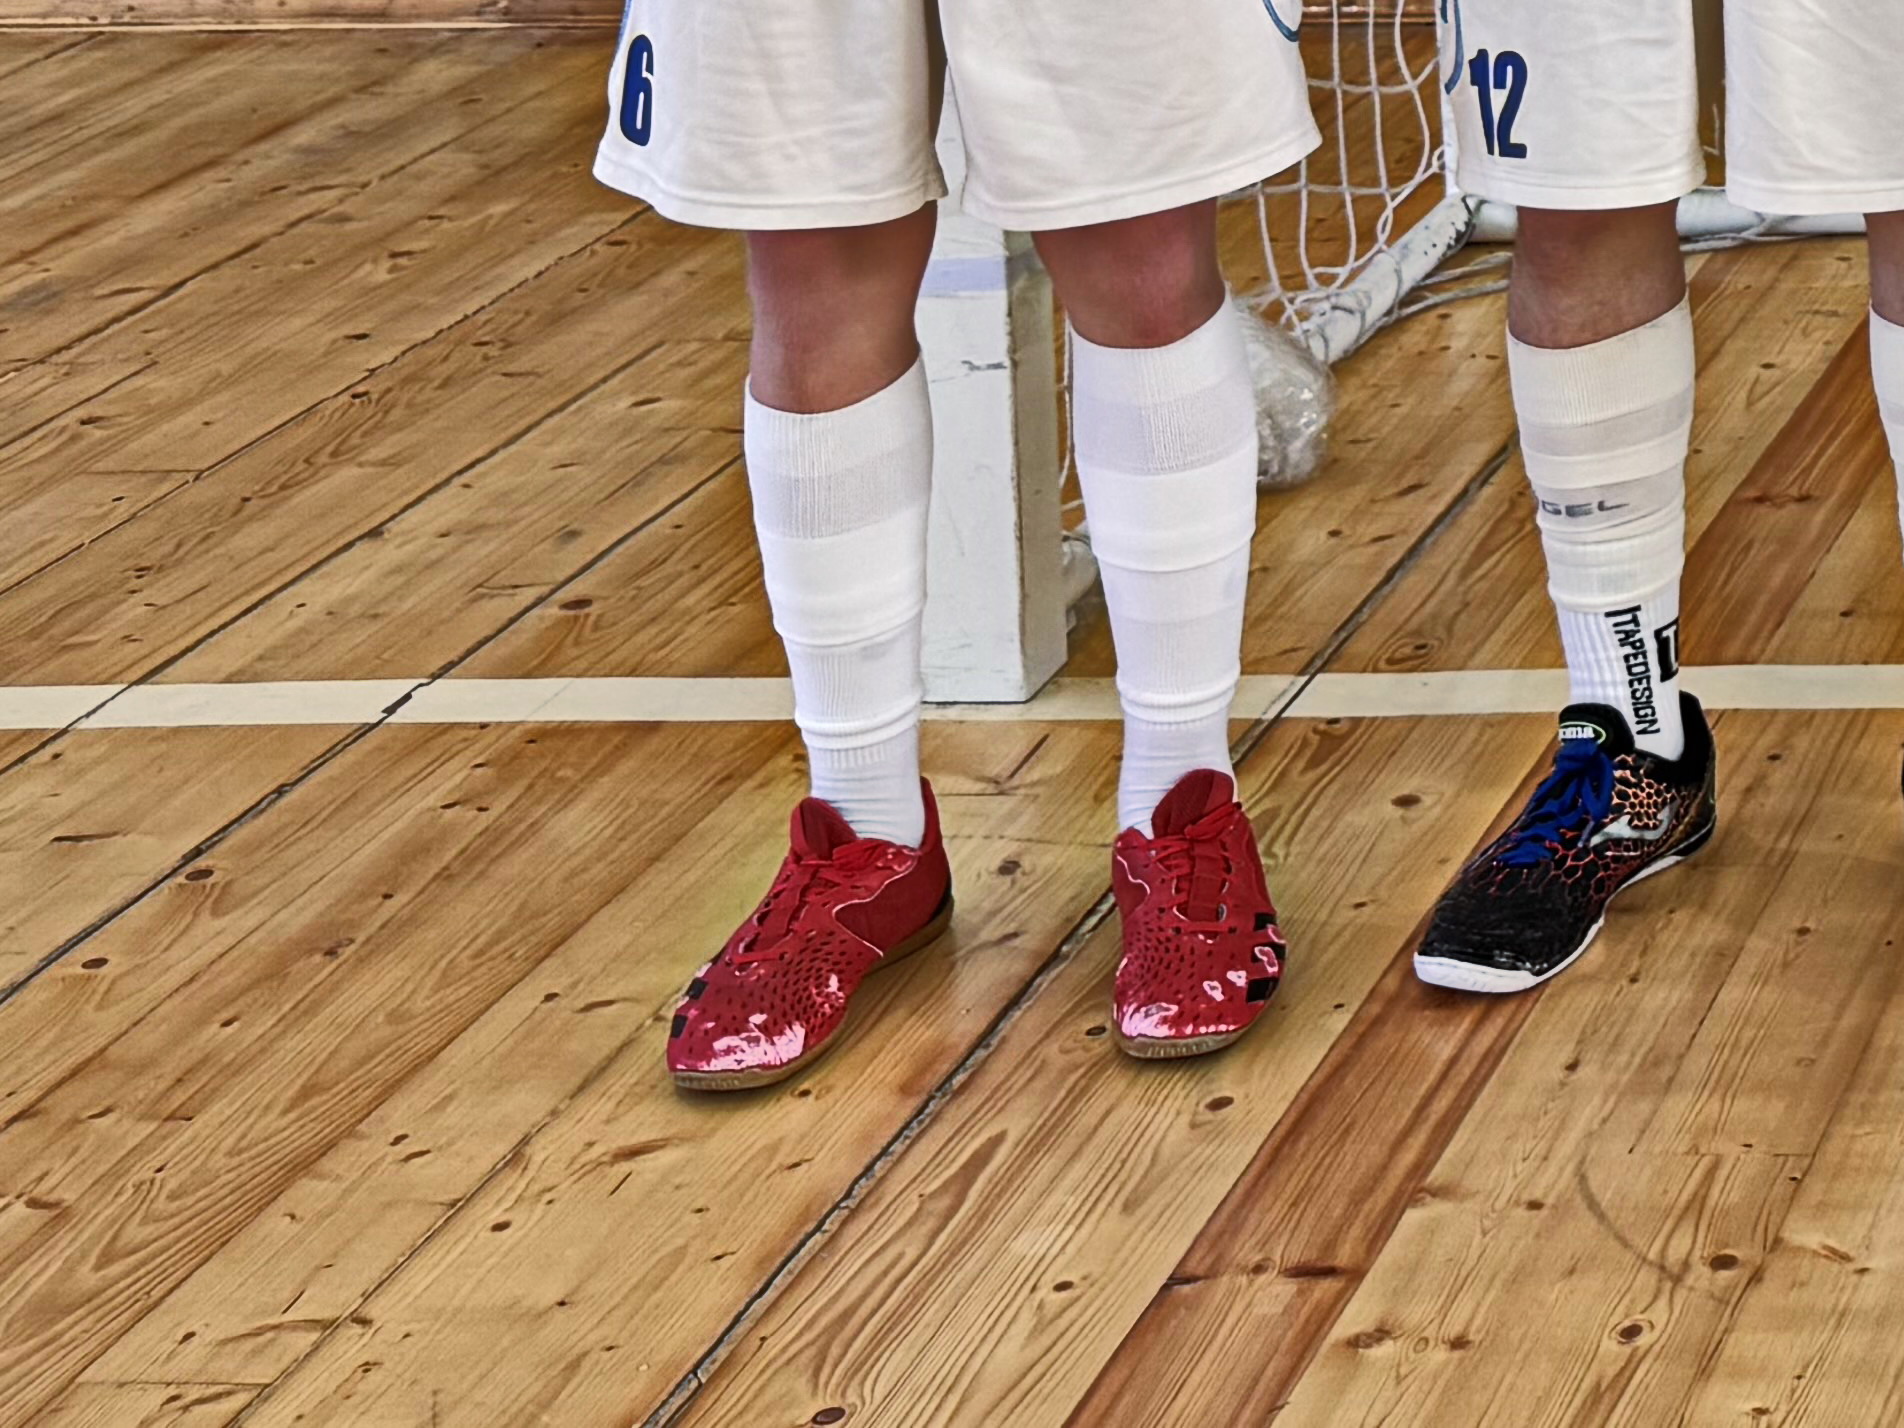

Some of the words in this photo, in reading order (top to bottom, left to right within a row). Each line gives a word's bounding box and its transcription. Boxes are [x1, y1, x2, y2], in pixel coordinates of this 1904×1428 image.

[619, 34, 655, 147] 6
[1468, 48, 1528, 159] 12
[1611, 611, 1662, 737] TAPEDESIGN
